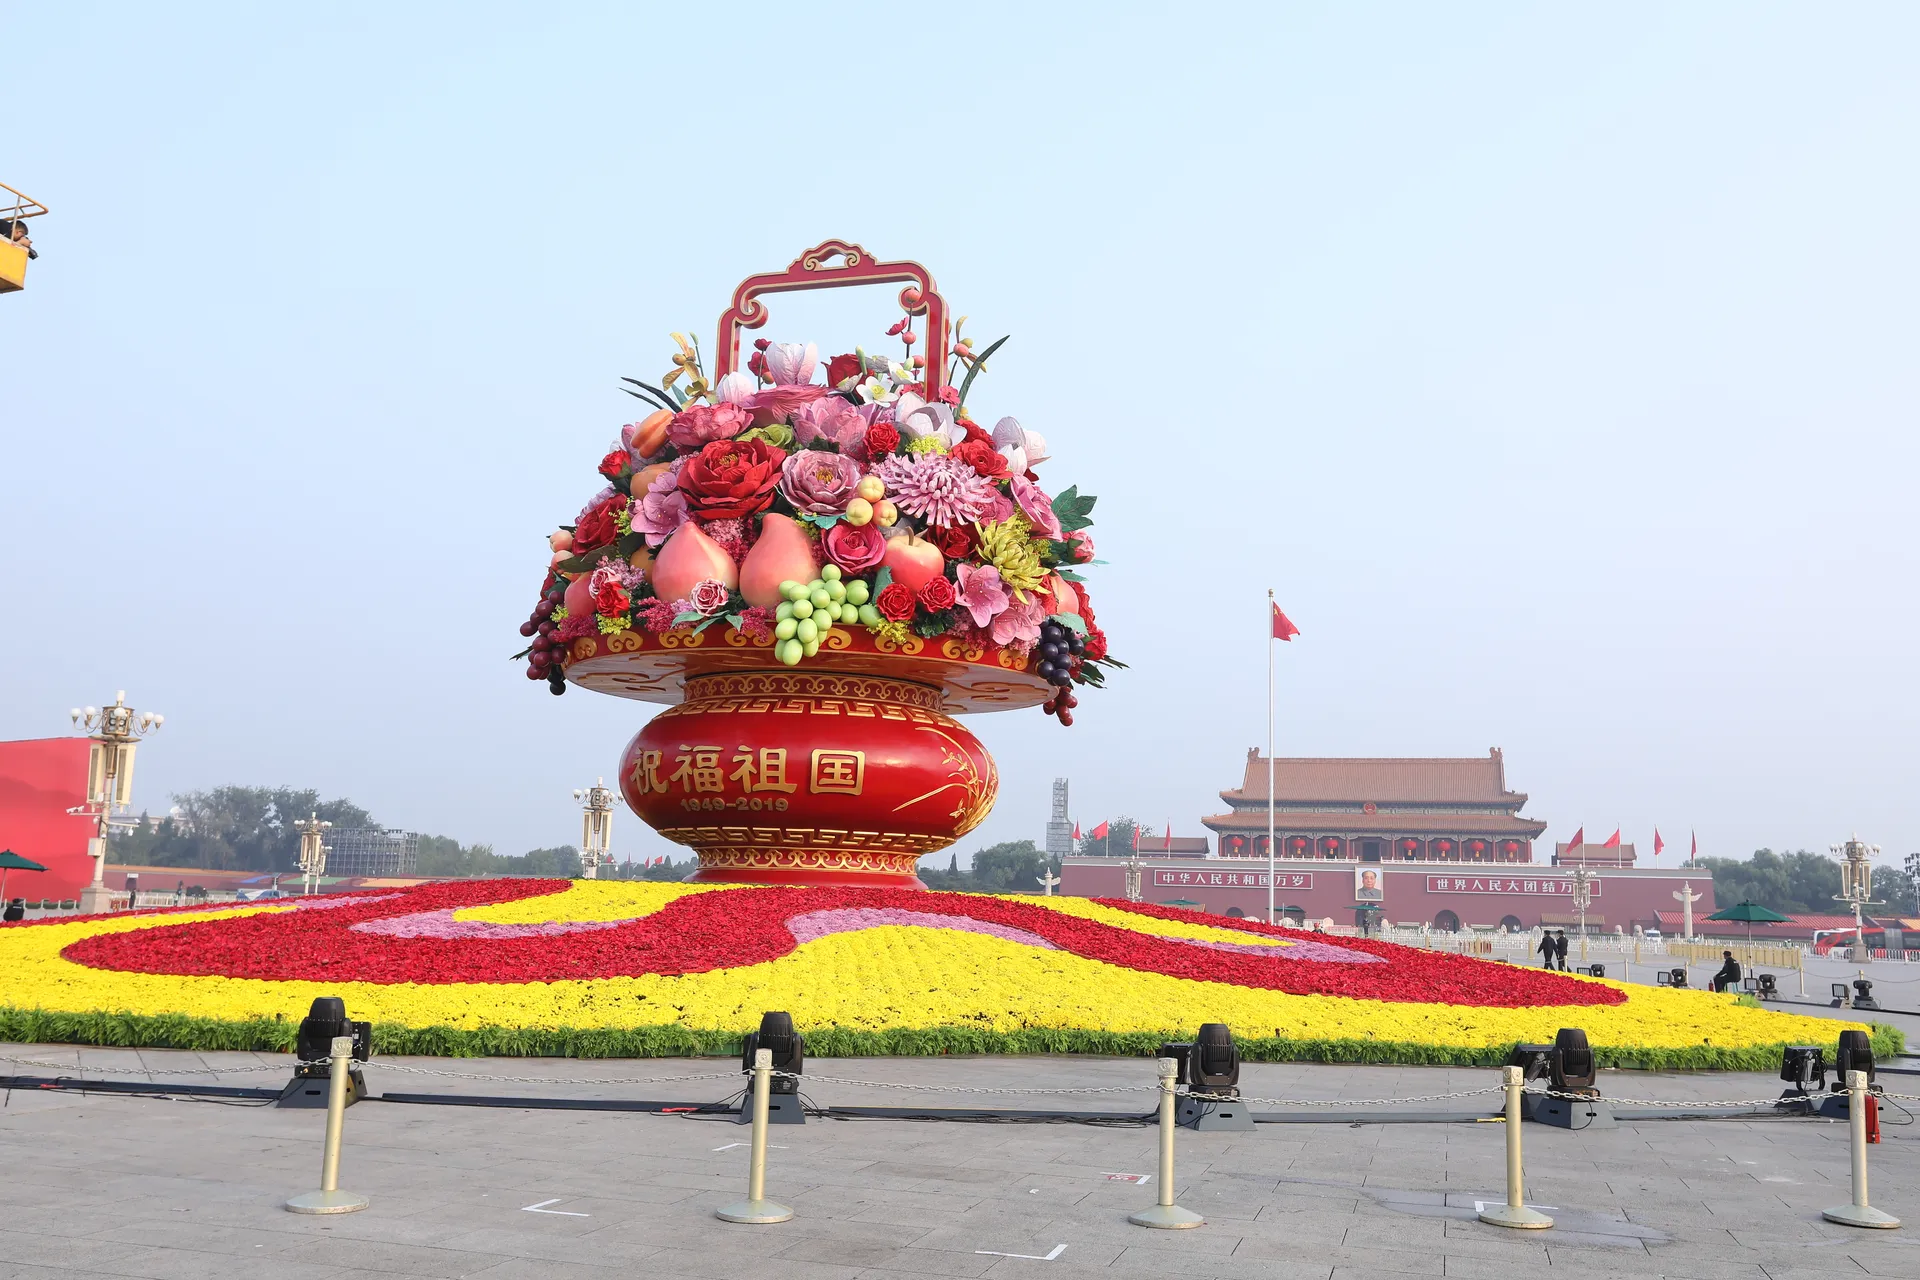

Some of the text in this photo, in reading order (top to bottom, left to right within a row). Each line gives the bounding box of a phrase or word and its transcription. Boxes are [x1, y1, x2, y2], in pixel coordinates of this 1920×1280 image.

[630, 744, 865, 796] 祝福祖国
[680, 797, 789, 812] 1949-2019
[1162, 872, 1305, 887] 中华人民共和国万岁
[1436, 878, 1590, 893] 世界人民大团结万
